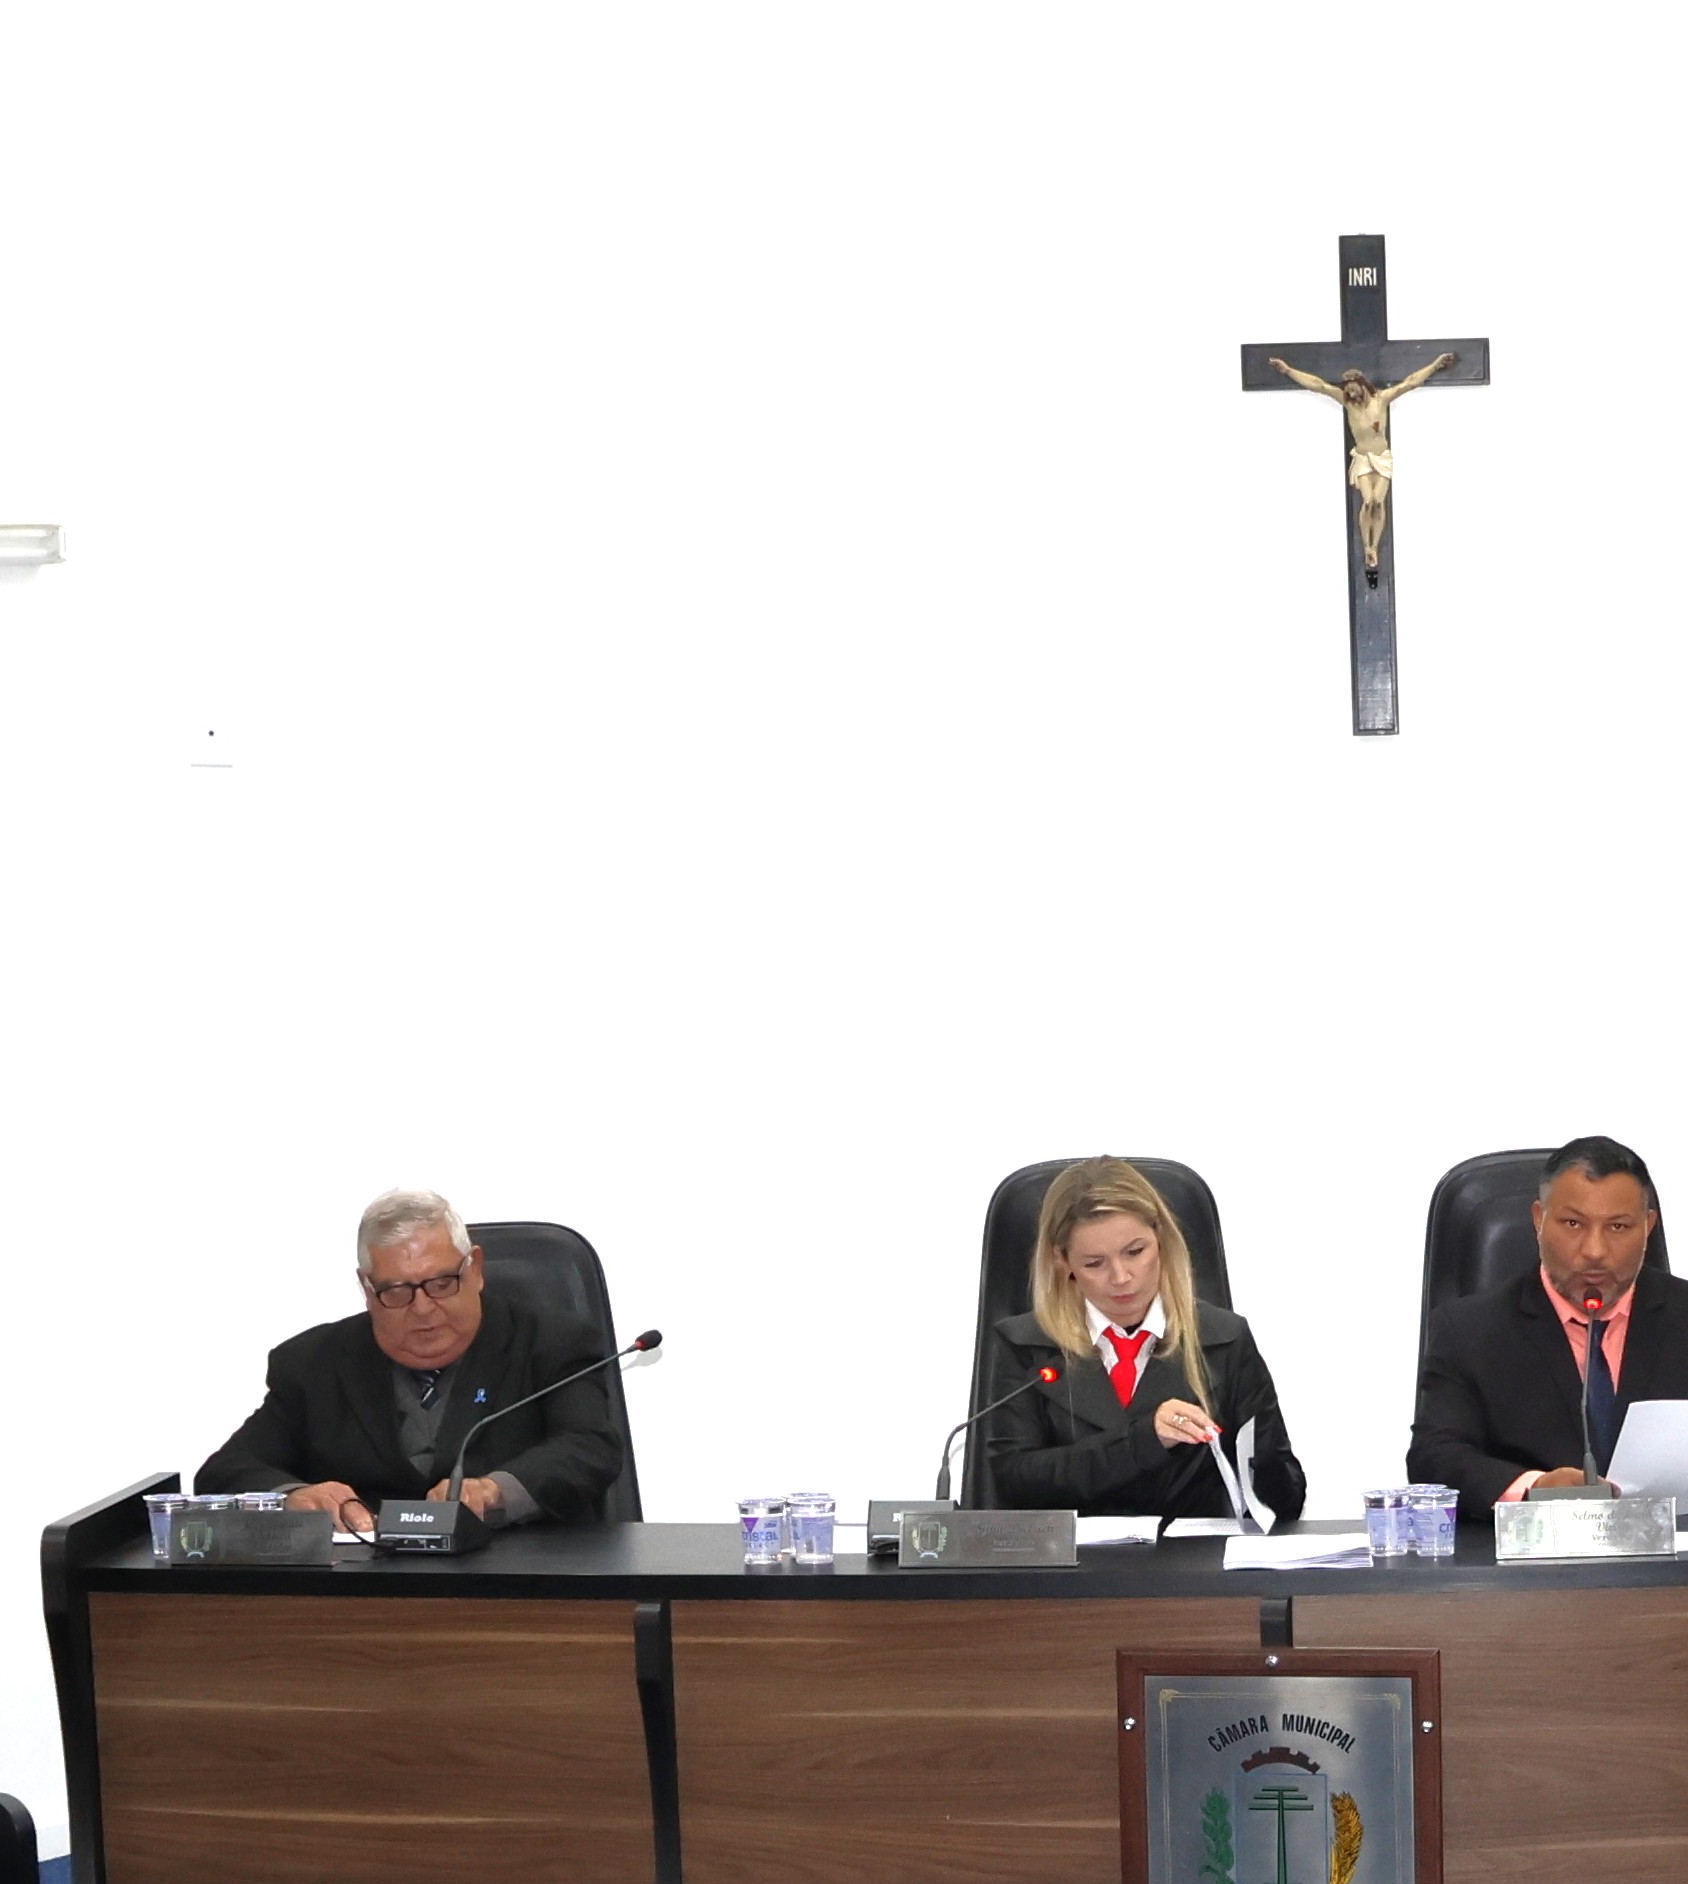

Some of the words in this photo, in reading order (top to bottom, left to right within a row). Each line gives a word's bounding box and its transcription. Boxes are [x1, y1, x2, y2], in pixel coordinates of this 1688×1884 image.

[1348, 267, 1377, 286] INRI
[400, 1512, 435, 1523] Riole
[1208, 1715, 1269, 1752] CÂMARA
[1282, 1713, 1356, 1754] MUNICIPAL
